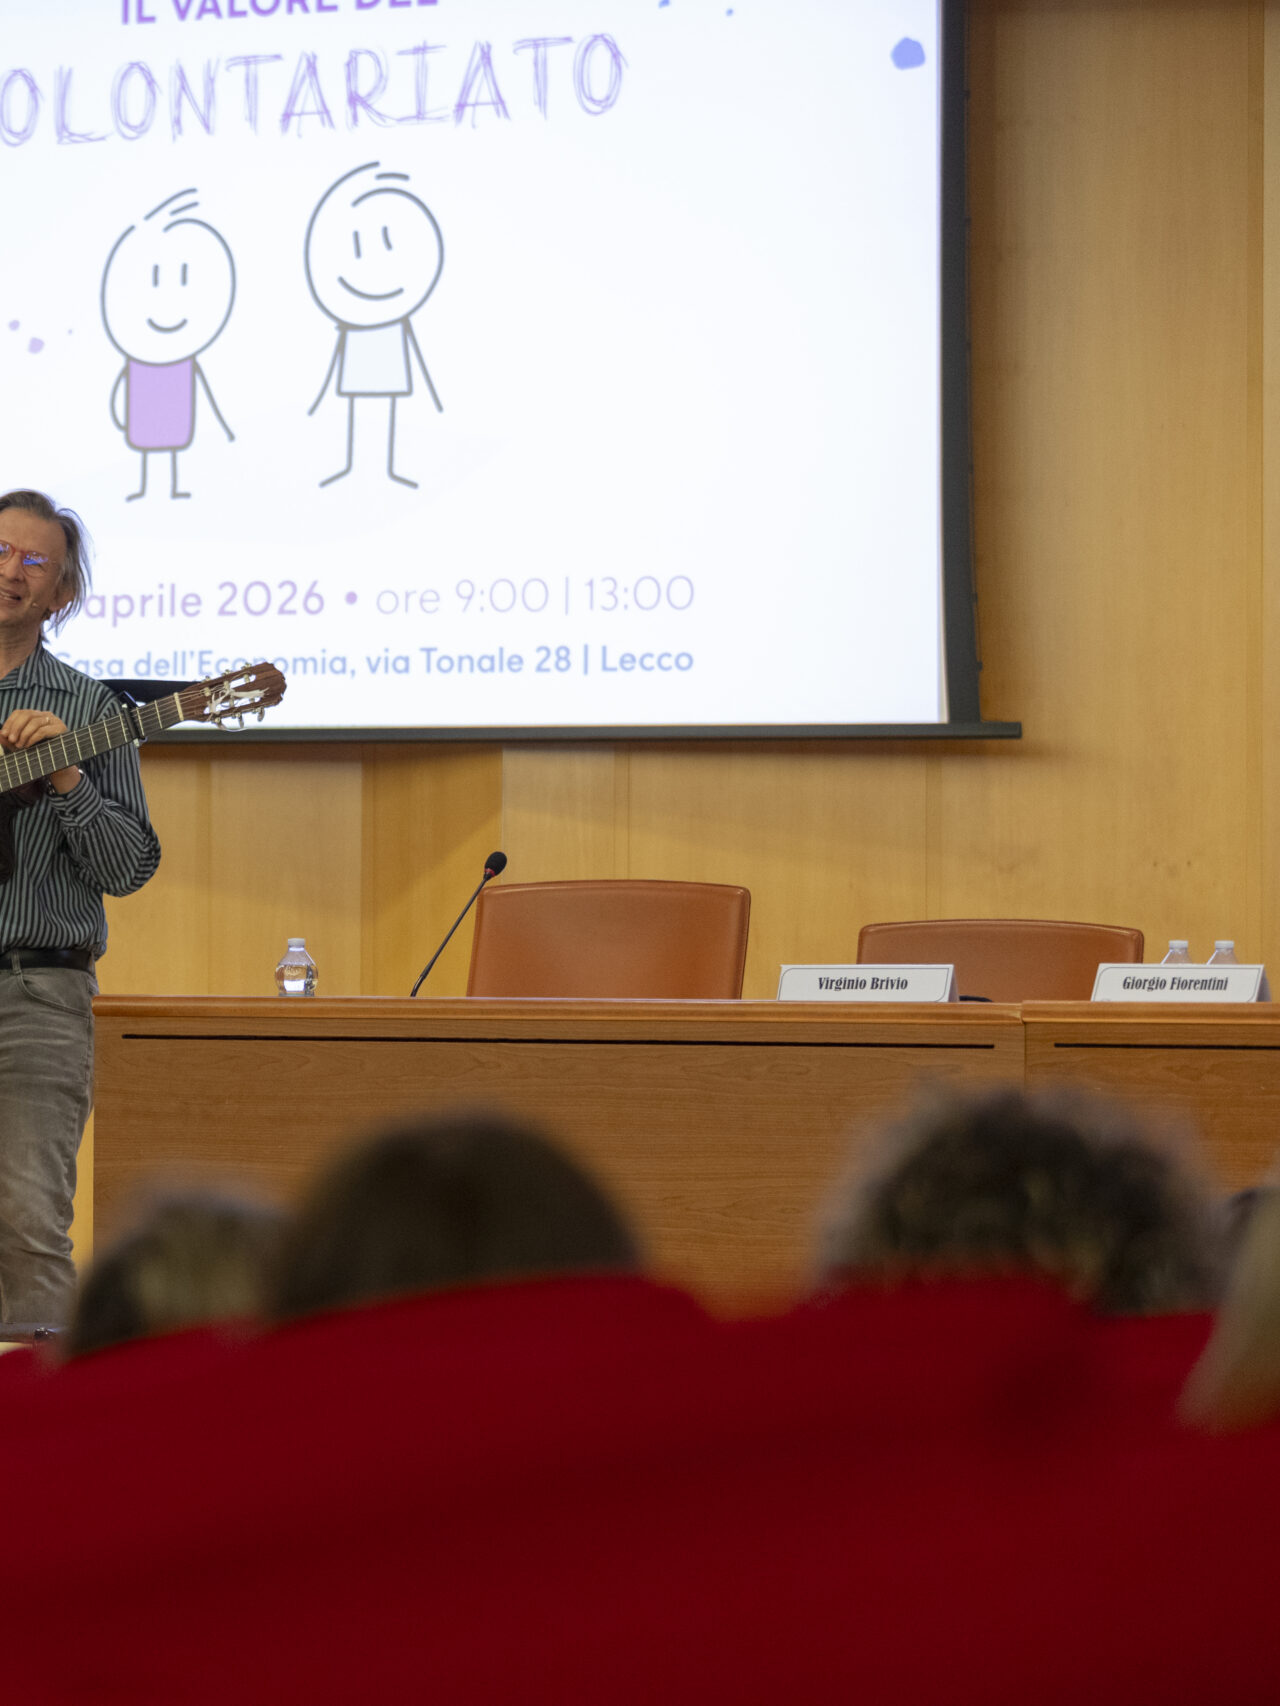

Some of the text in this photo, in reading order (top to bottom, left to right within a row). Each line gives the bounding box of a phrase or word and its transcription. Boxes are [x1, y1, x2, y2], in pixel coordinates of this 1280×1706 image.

[121, 0, 156, 25] IL
[83, 582, 202, 628] aprile
[217, 580, 325, 616] 2026
[376, 588, 441, 616] ore
[455, 578, 550, 614] 9:00
[584, 575, 695, 612] 13:00
[365, 648, 411, 675] via
[419, 646, 525, 675] Tonale
[534, 645, 572, 673] 28
[600, 644, 695, 673] Lecco
[818, 976, 909, 992] Virginio Brivio
[1122, 976, 1229, 992] Giorgio Fiorentini
